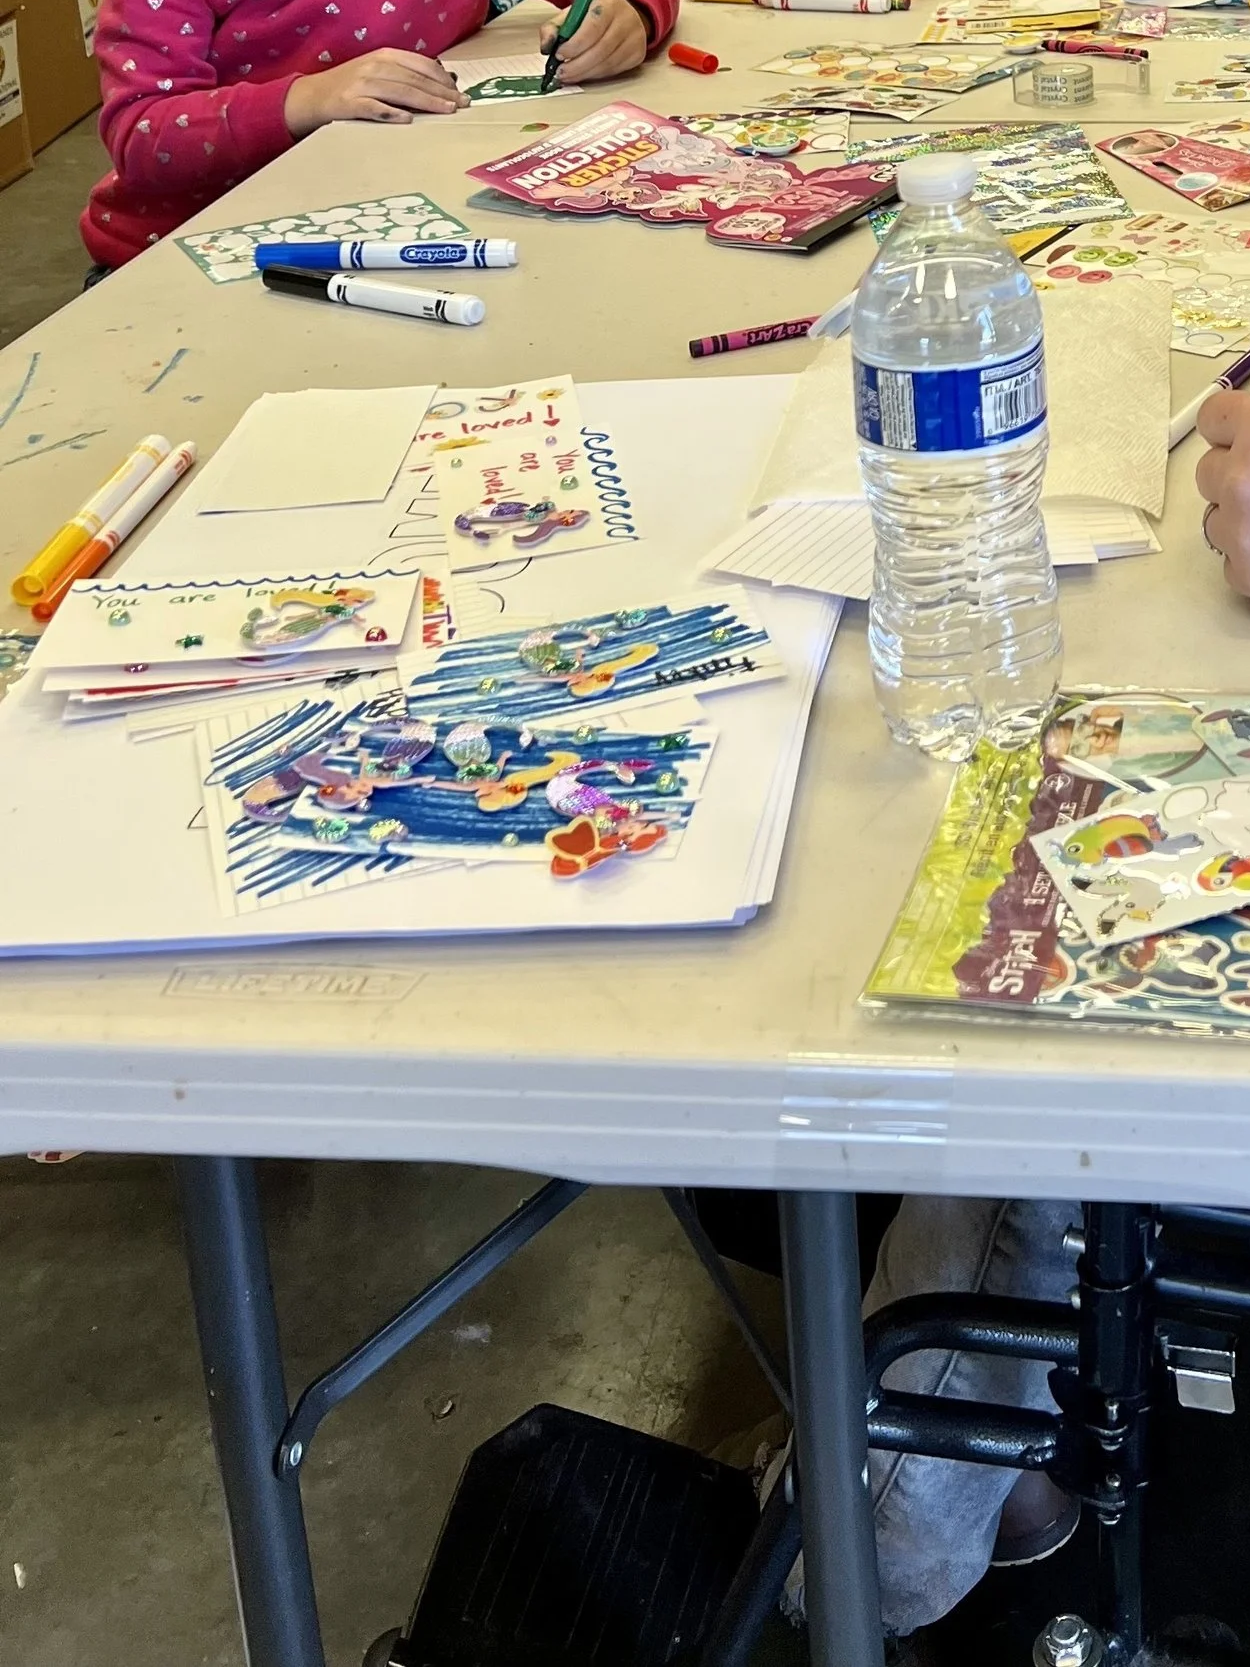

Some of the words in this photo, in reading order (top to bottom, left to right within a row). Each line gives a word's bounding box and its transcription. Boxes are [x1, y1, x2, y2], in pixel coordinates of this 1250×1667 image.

[510, 121, 654, 191] COLLECTION
[558, 139, 659, 188] STICKER
[405, 247, 459, 262] Crayola
[411, 430, 447, 443] re
[461, 412, 534, 435] loved
[518, 452, 541, 473] are
[552, 449, 581, 475] You
[92, 593, 141, 611] You
[168, 591, 217, 606] are
[193, 972, 396, 995] LIFETIME
